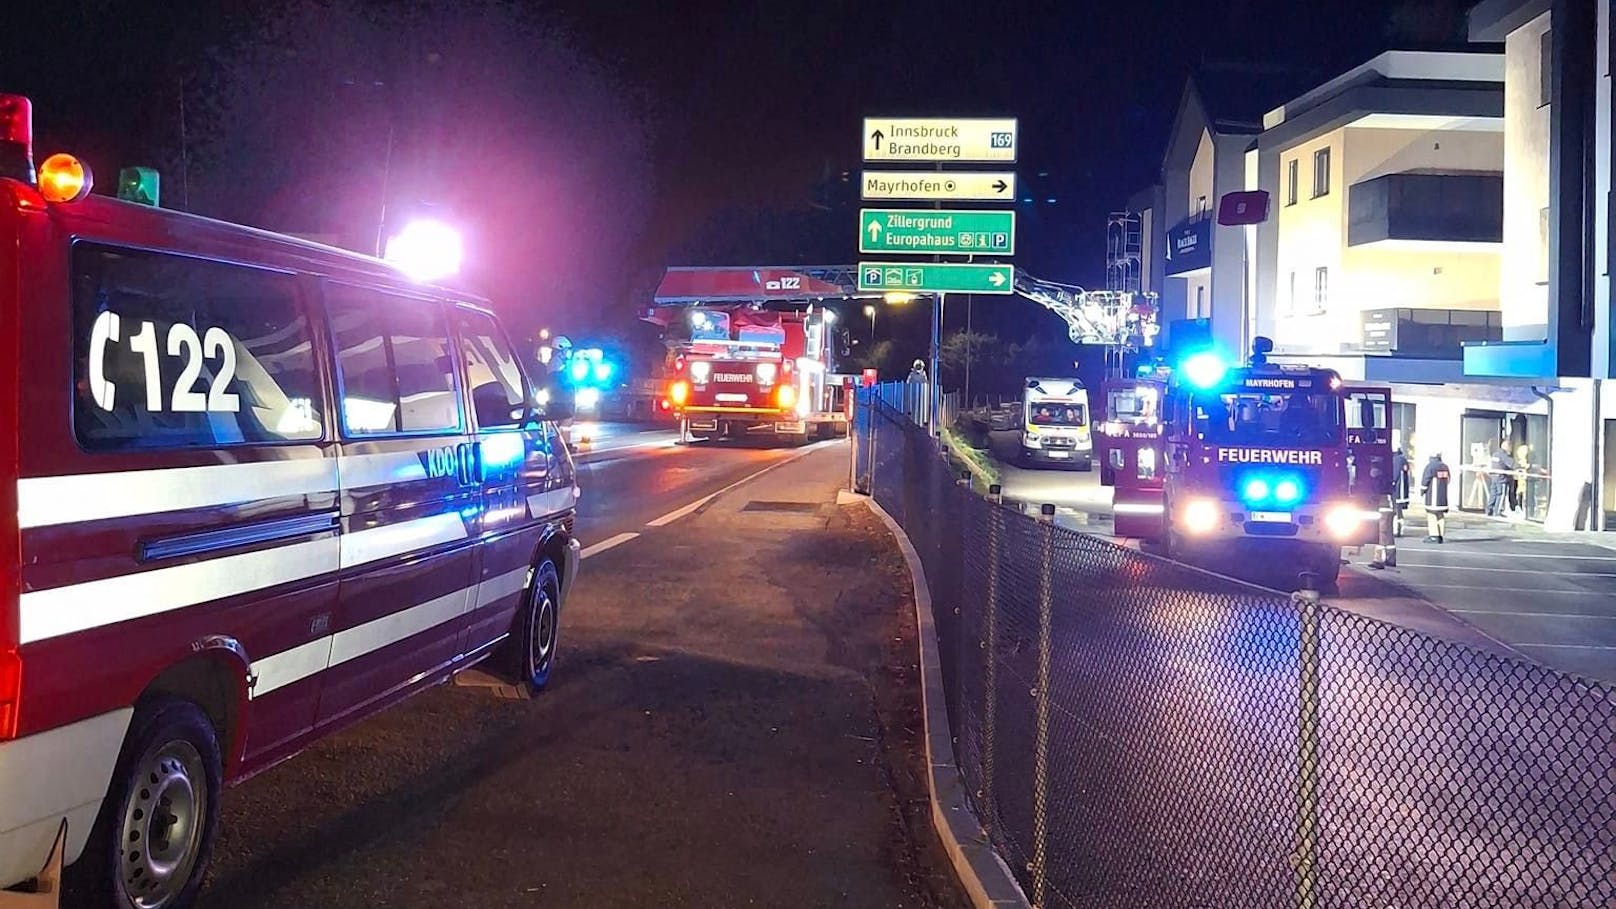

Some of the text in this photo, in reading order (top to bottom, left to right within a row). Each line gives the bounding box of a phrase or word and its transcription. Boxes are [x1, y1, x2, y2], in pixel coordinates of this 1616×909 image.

[890, 125, 959, 138] Innsbruck
[991, 133, 1012, 147] 169
[889, 142, 961, 157] Brandberg
[867, 179, 941, 194] Mayrhofen
[886, 215, 952, 230] Zillergrund
[886, 233, 955, 248] Europahaus
[781, 277, 800, 289] 122
[129, 321, 240, 412] 122
[713, 373, 753, 383] FEUERWEHR
[1246, 378, 1295, 389] MAYRHOFEN
[1218, 447, 1323, 465] FEUERWEHR
